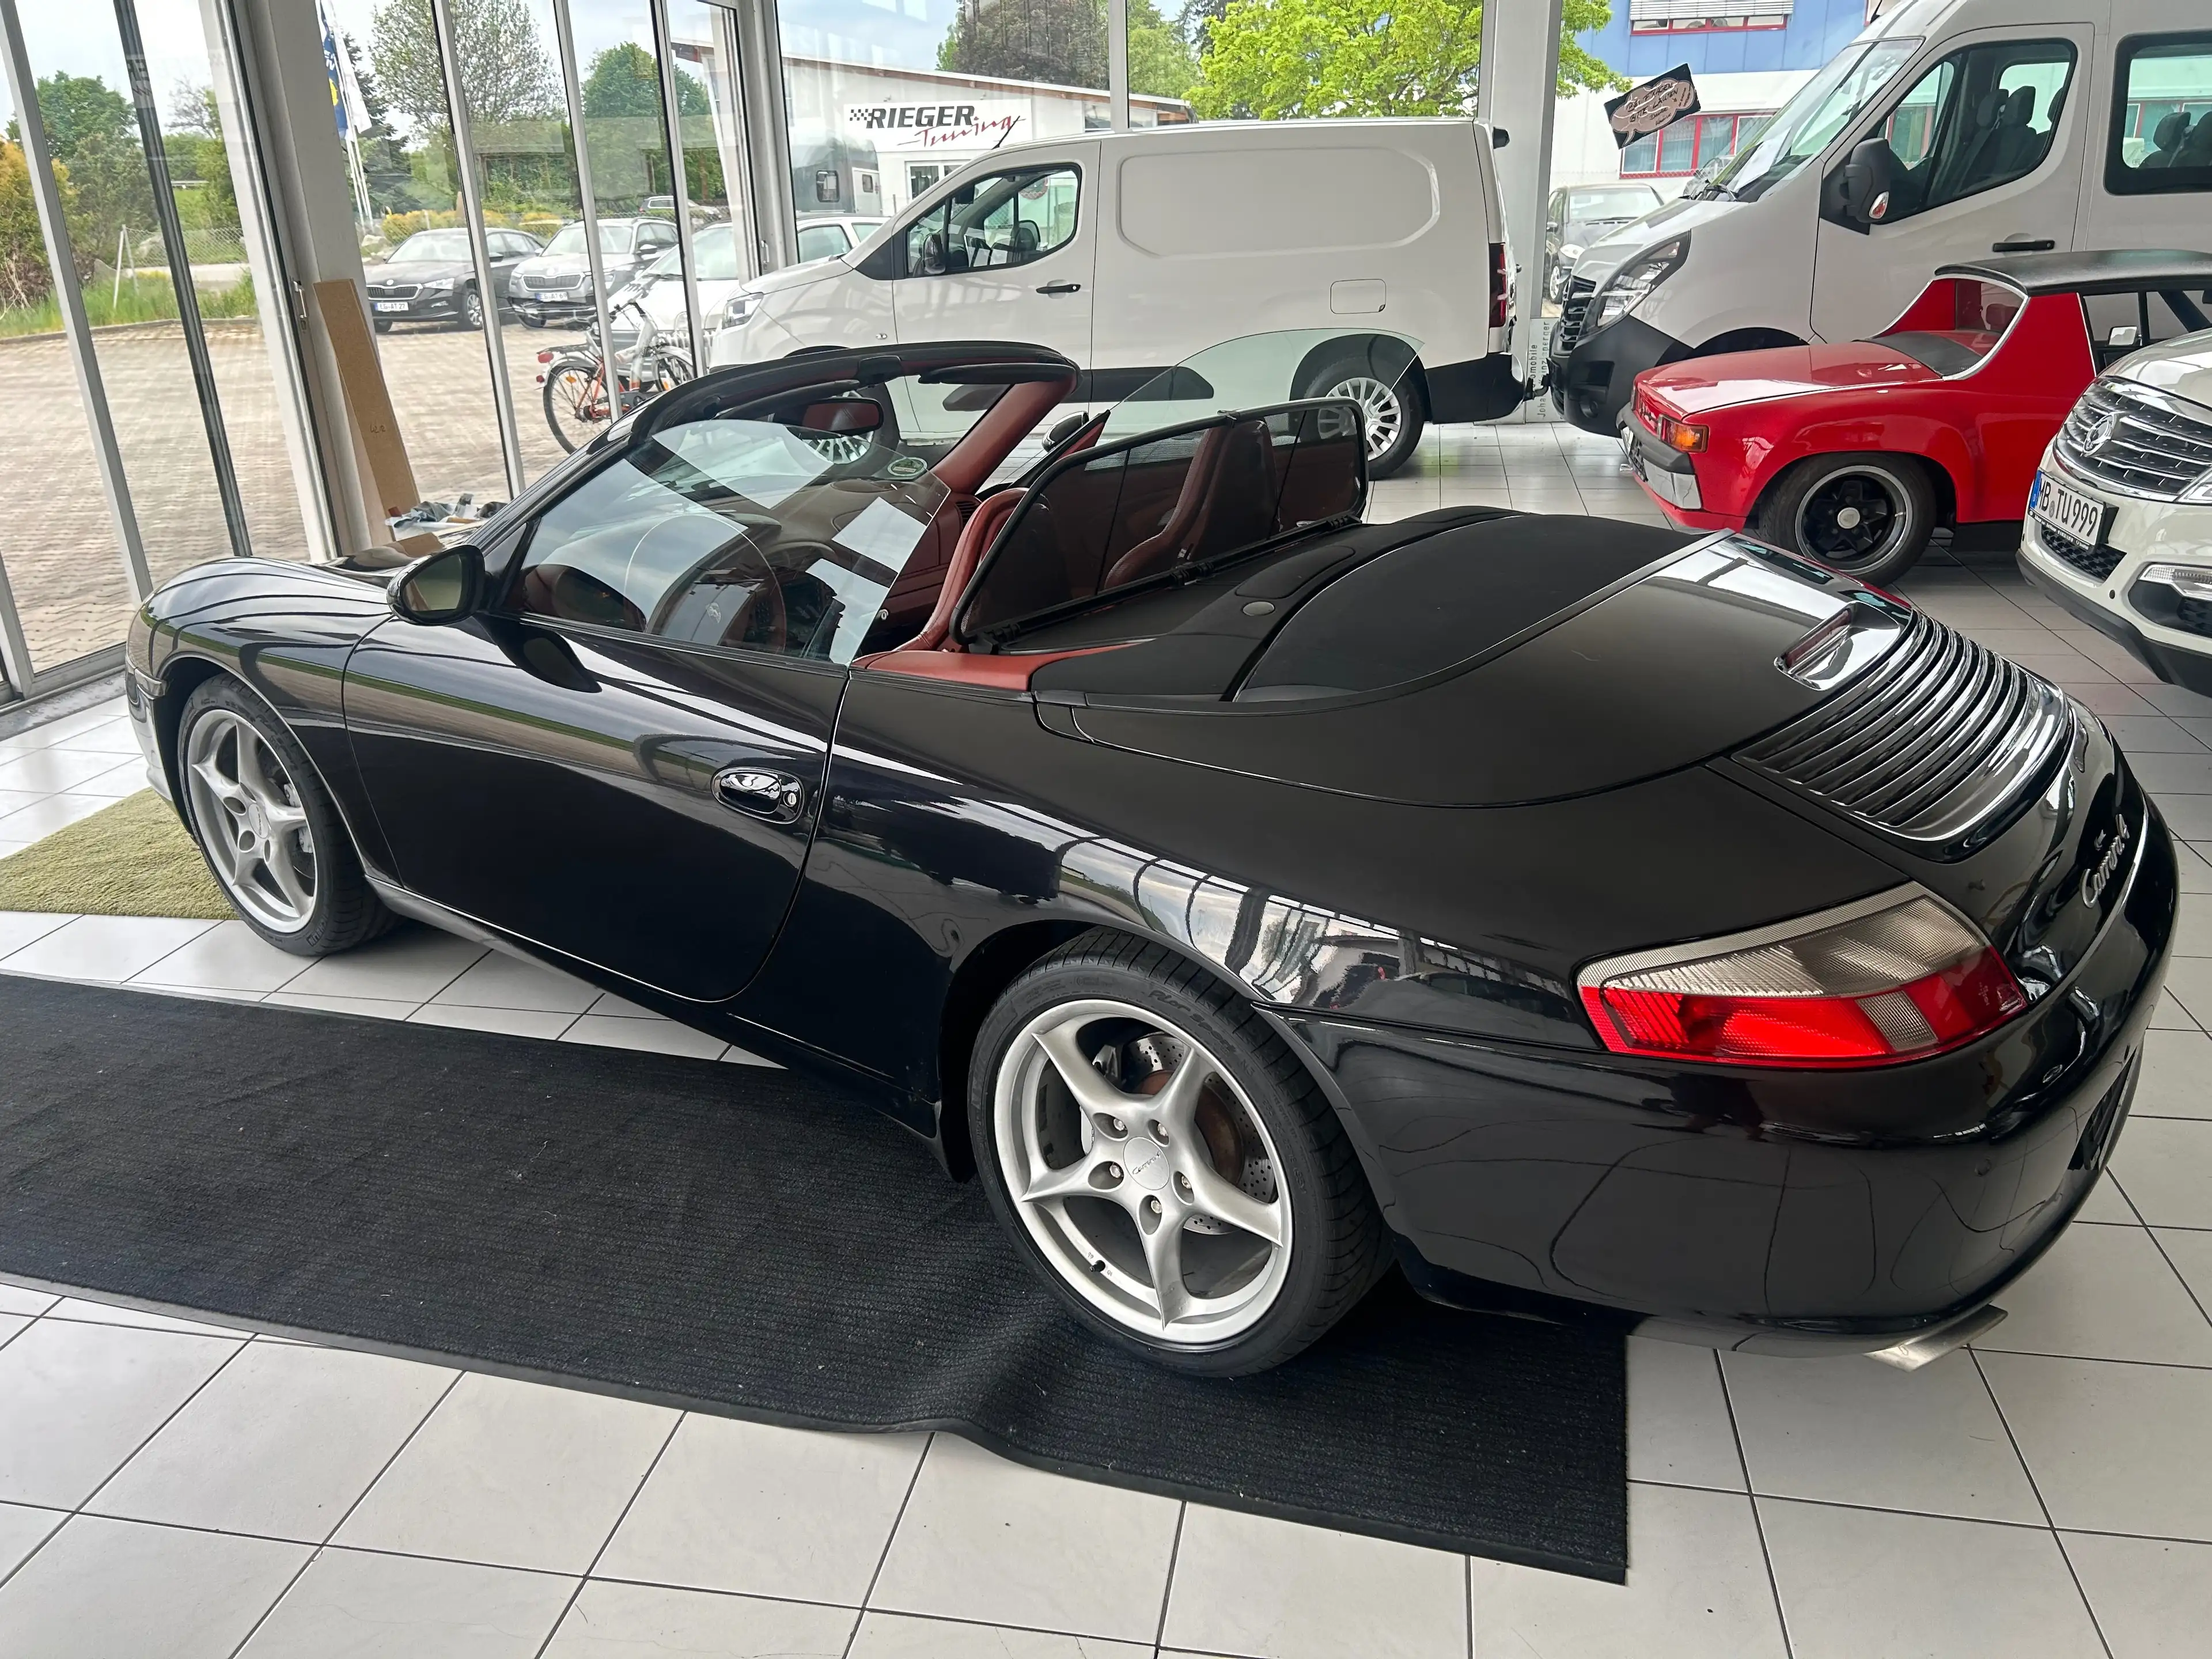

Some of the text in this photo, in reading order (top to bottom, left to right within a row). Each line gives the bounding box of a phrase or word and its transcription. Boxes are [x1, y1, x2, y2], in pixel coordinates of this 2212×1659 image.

[866, 105, 975, 129] RIEGER
[900, 115, 1026, 147] Tuning
[1528, 344, 1537, 388] omobile
[1537, 396, 1546, 418] Joha
[2079, 814, 2130, 908] Carrera
